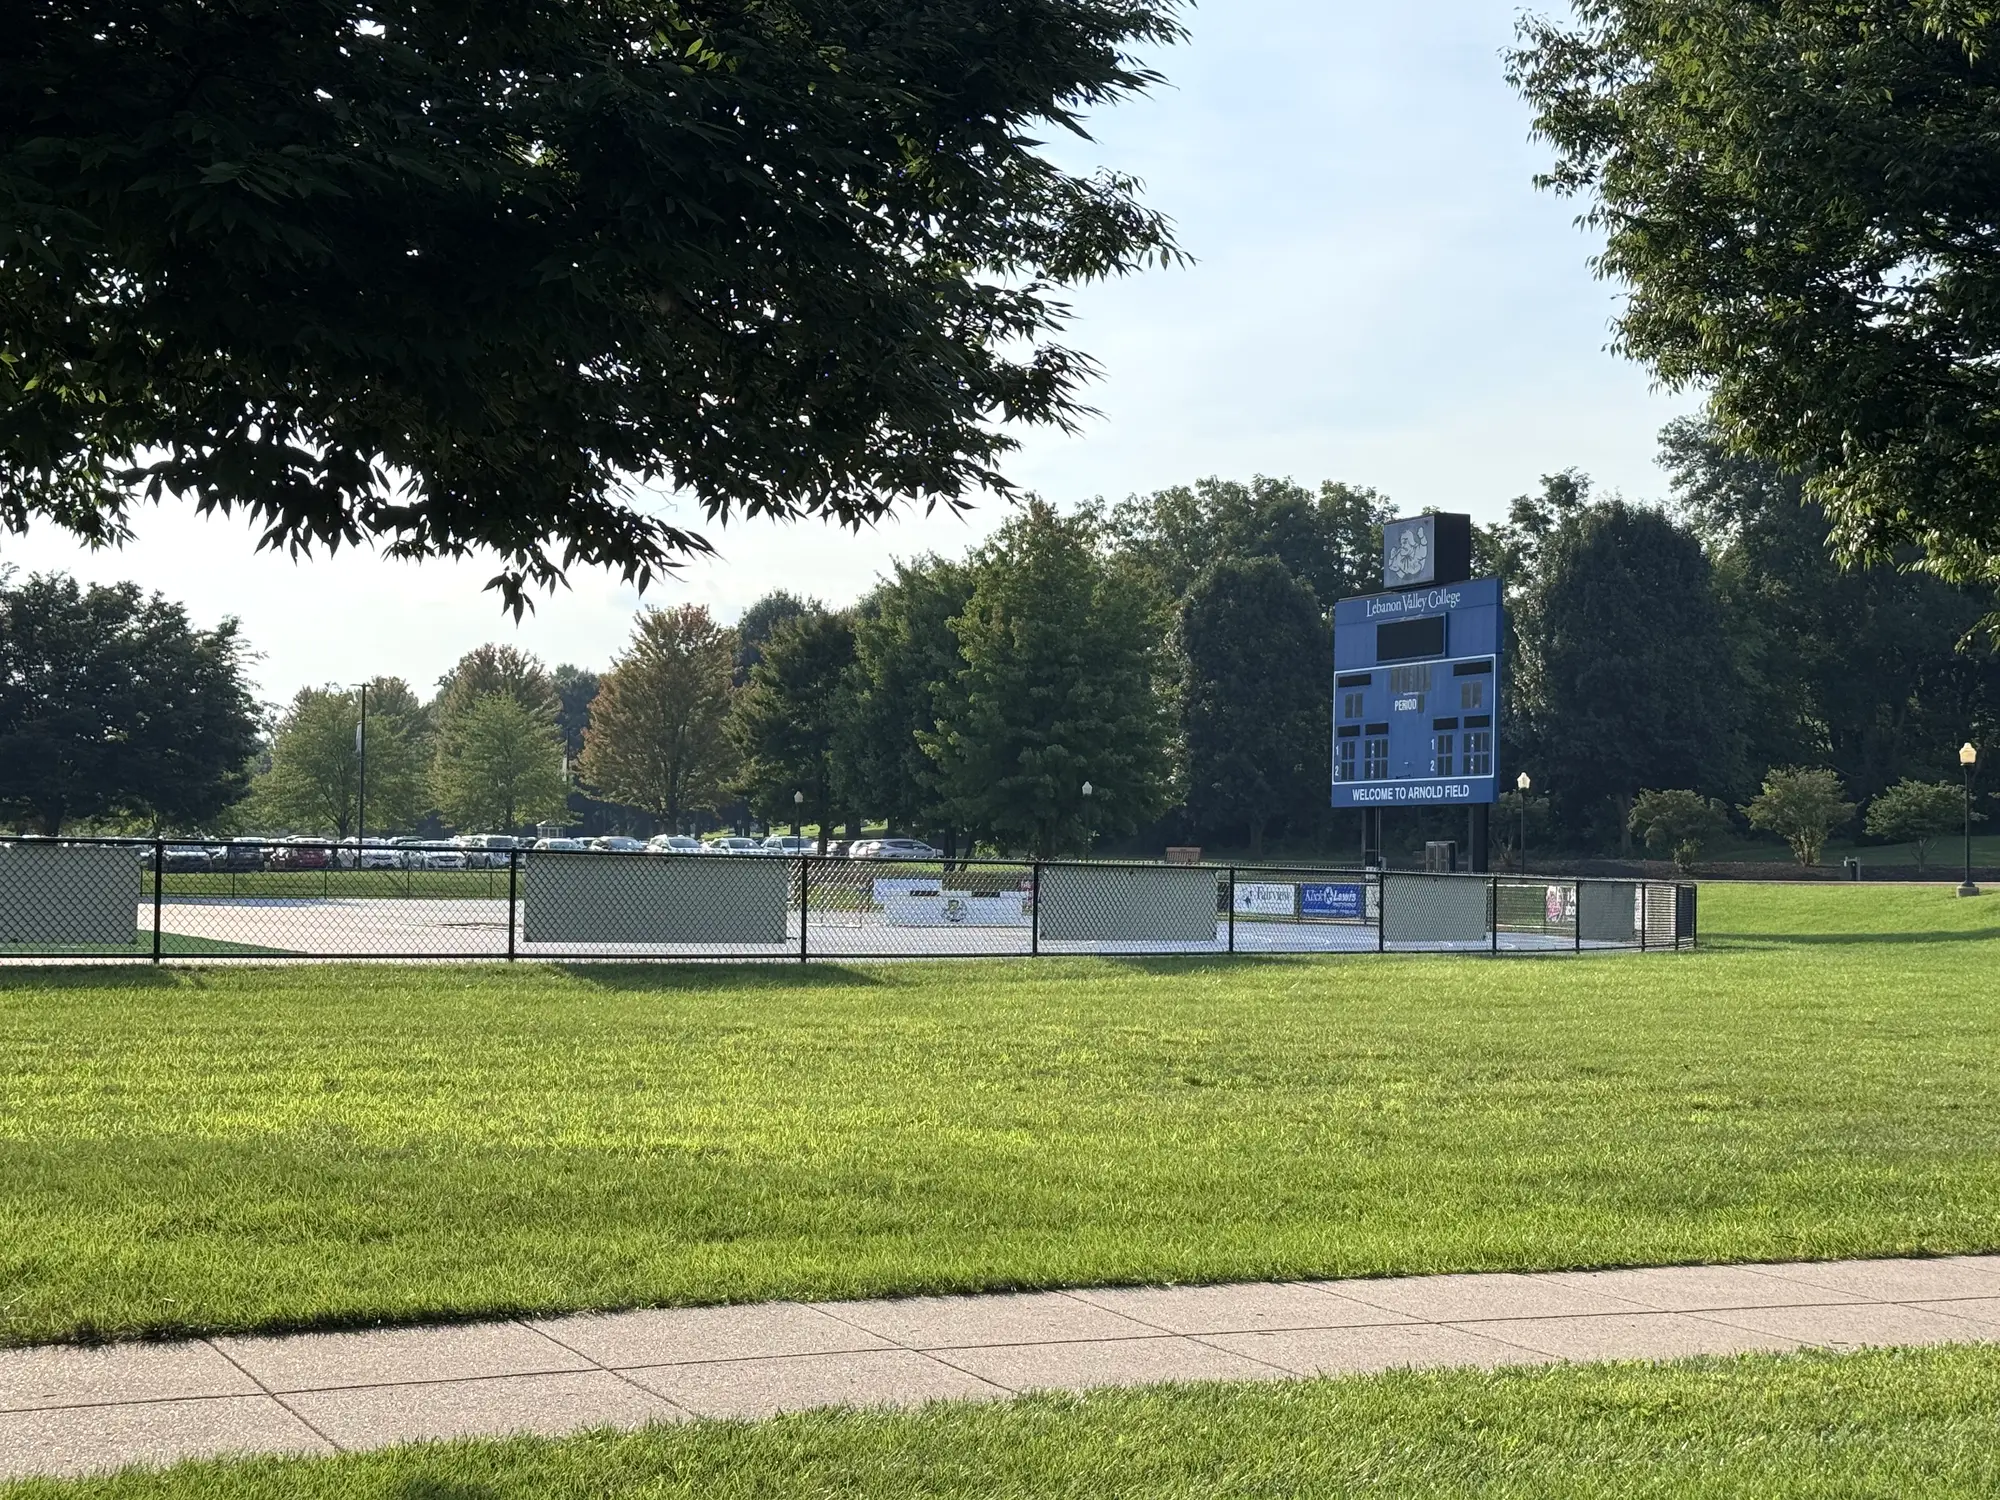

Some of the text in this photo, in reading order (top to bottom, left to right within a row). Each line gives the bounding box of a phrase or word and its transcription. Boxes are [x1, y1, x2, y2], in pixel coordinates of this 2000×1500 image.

[1367, 588, 1461, 618] Lebanon Valley College
[1394, 698, 1417, 711] PERIOD
[1334, 765, 1339, 776] 2
[1430, 760, 1435, 771] 2
[1352, 784, 1470, 801] WELCOME TO ARNOLD FIELD
[1333, 890, 1357, 902] Lewis
